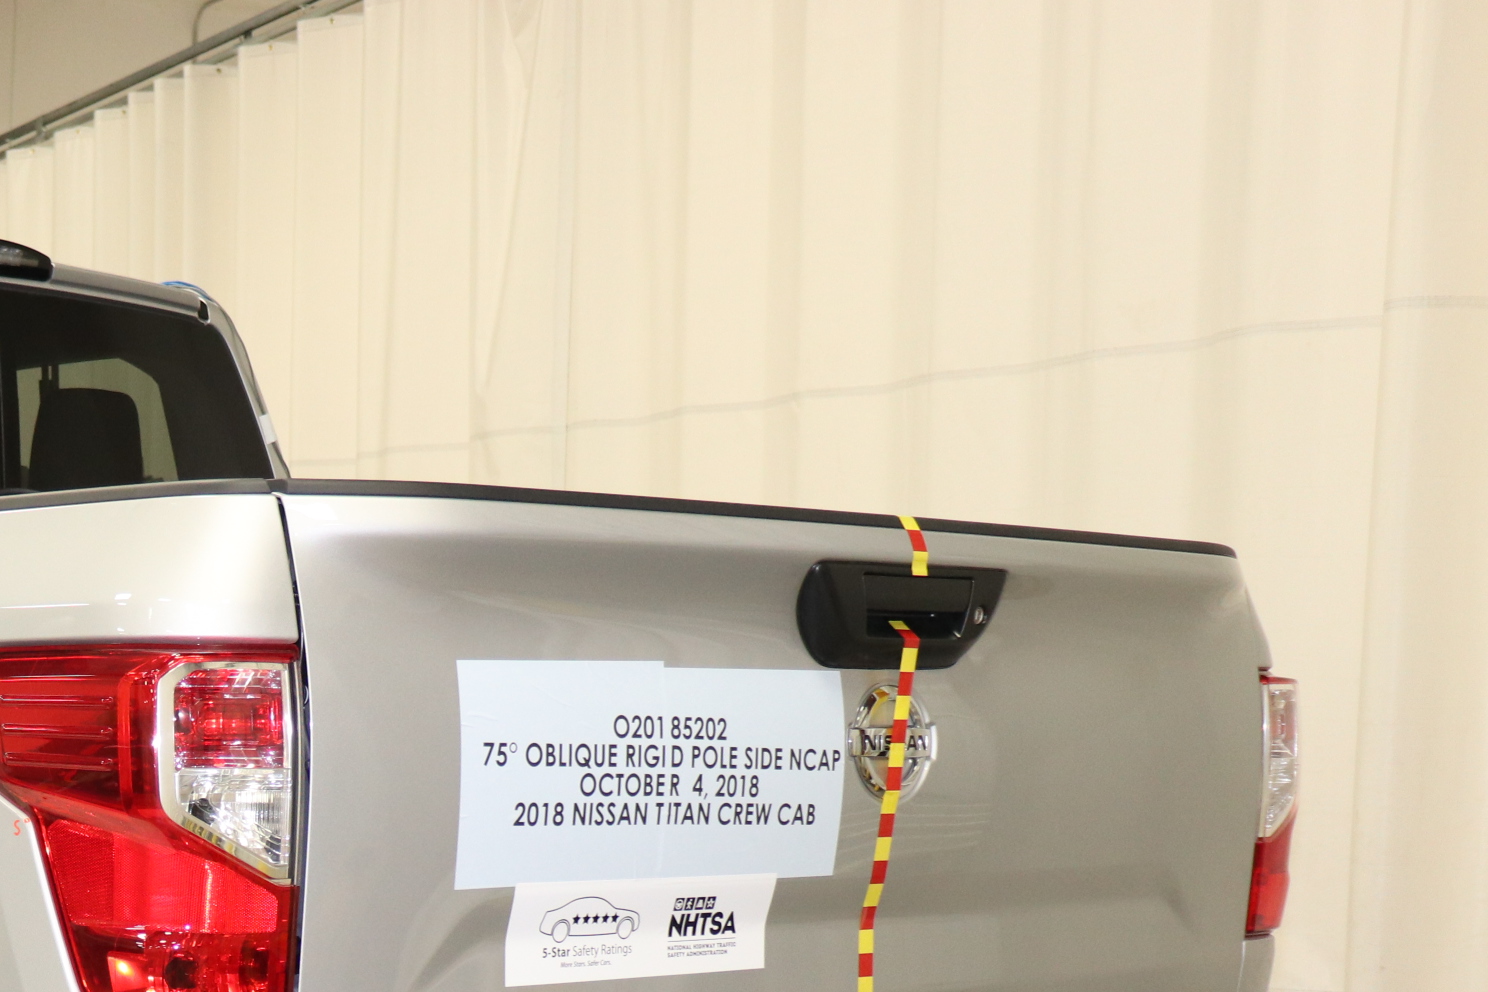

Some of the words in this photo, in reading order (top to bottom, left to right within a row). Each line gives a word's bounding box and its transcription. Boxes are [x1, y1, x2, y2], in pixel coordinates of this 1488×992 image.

[864, 734, 927, 751] NISAN
[525, 742, 618, 769] OBLIQUE
[625, 744, 684, 768] RIGID
[691, 745, 738, 769] POLE
[744, 746, 783, 770] SIDE
[789, 748, 841, 771] NCAP
[579, 772, 680, 797] OCTOBER
[692, 773, 709, 800] 4,
[715, 774, 759, 797] 2018
[513, 802, 565, 826] 2018
[572, 802, 648, 826] NISSAN
[656, 802, 711, 826] TITAN
[717, 802, 772, 826] CREW
[777, 803, 816, 826] CAB
[668, 911, 736, 937] NHTSA
[542, 947, 570, 958] 5-Star
[572, 945, 599, 958] Safety
[601, 944, 632, 956] Ratings
